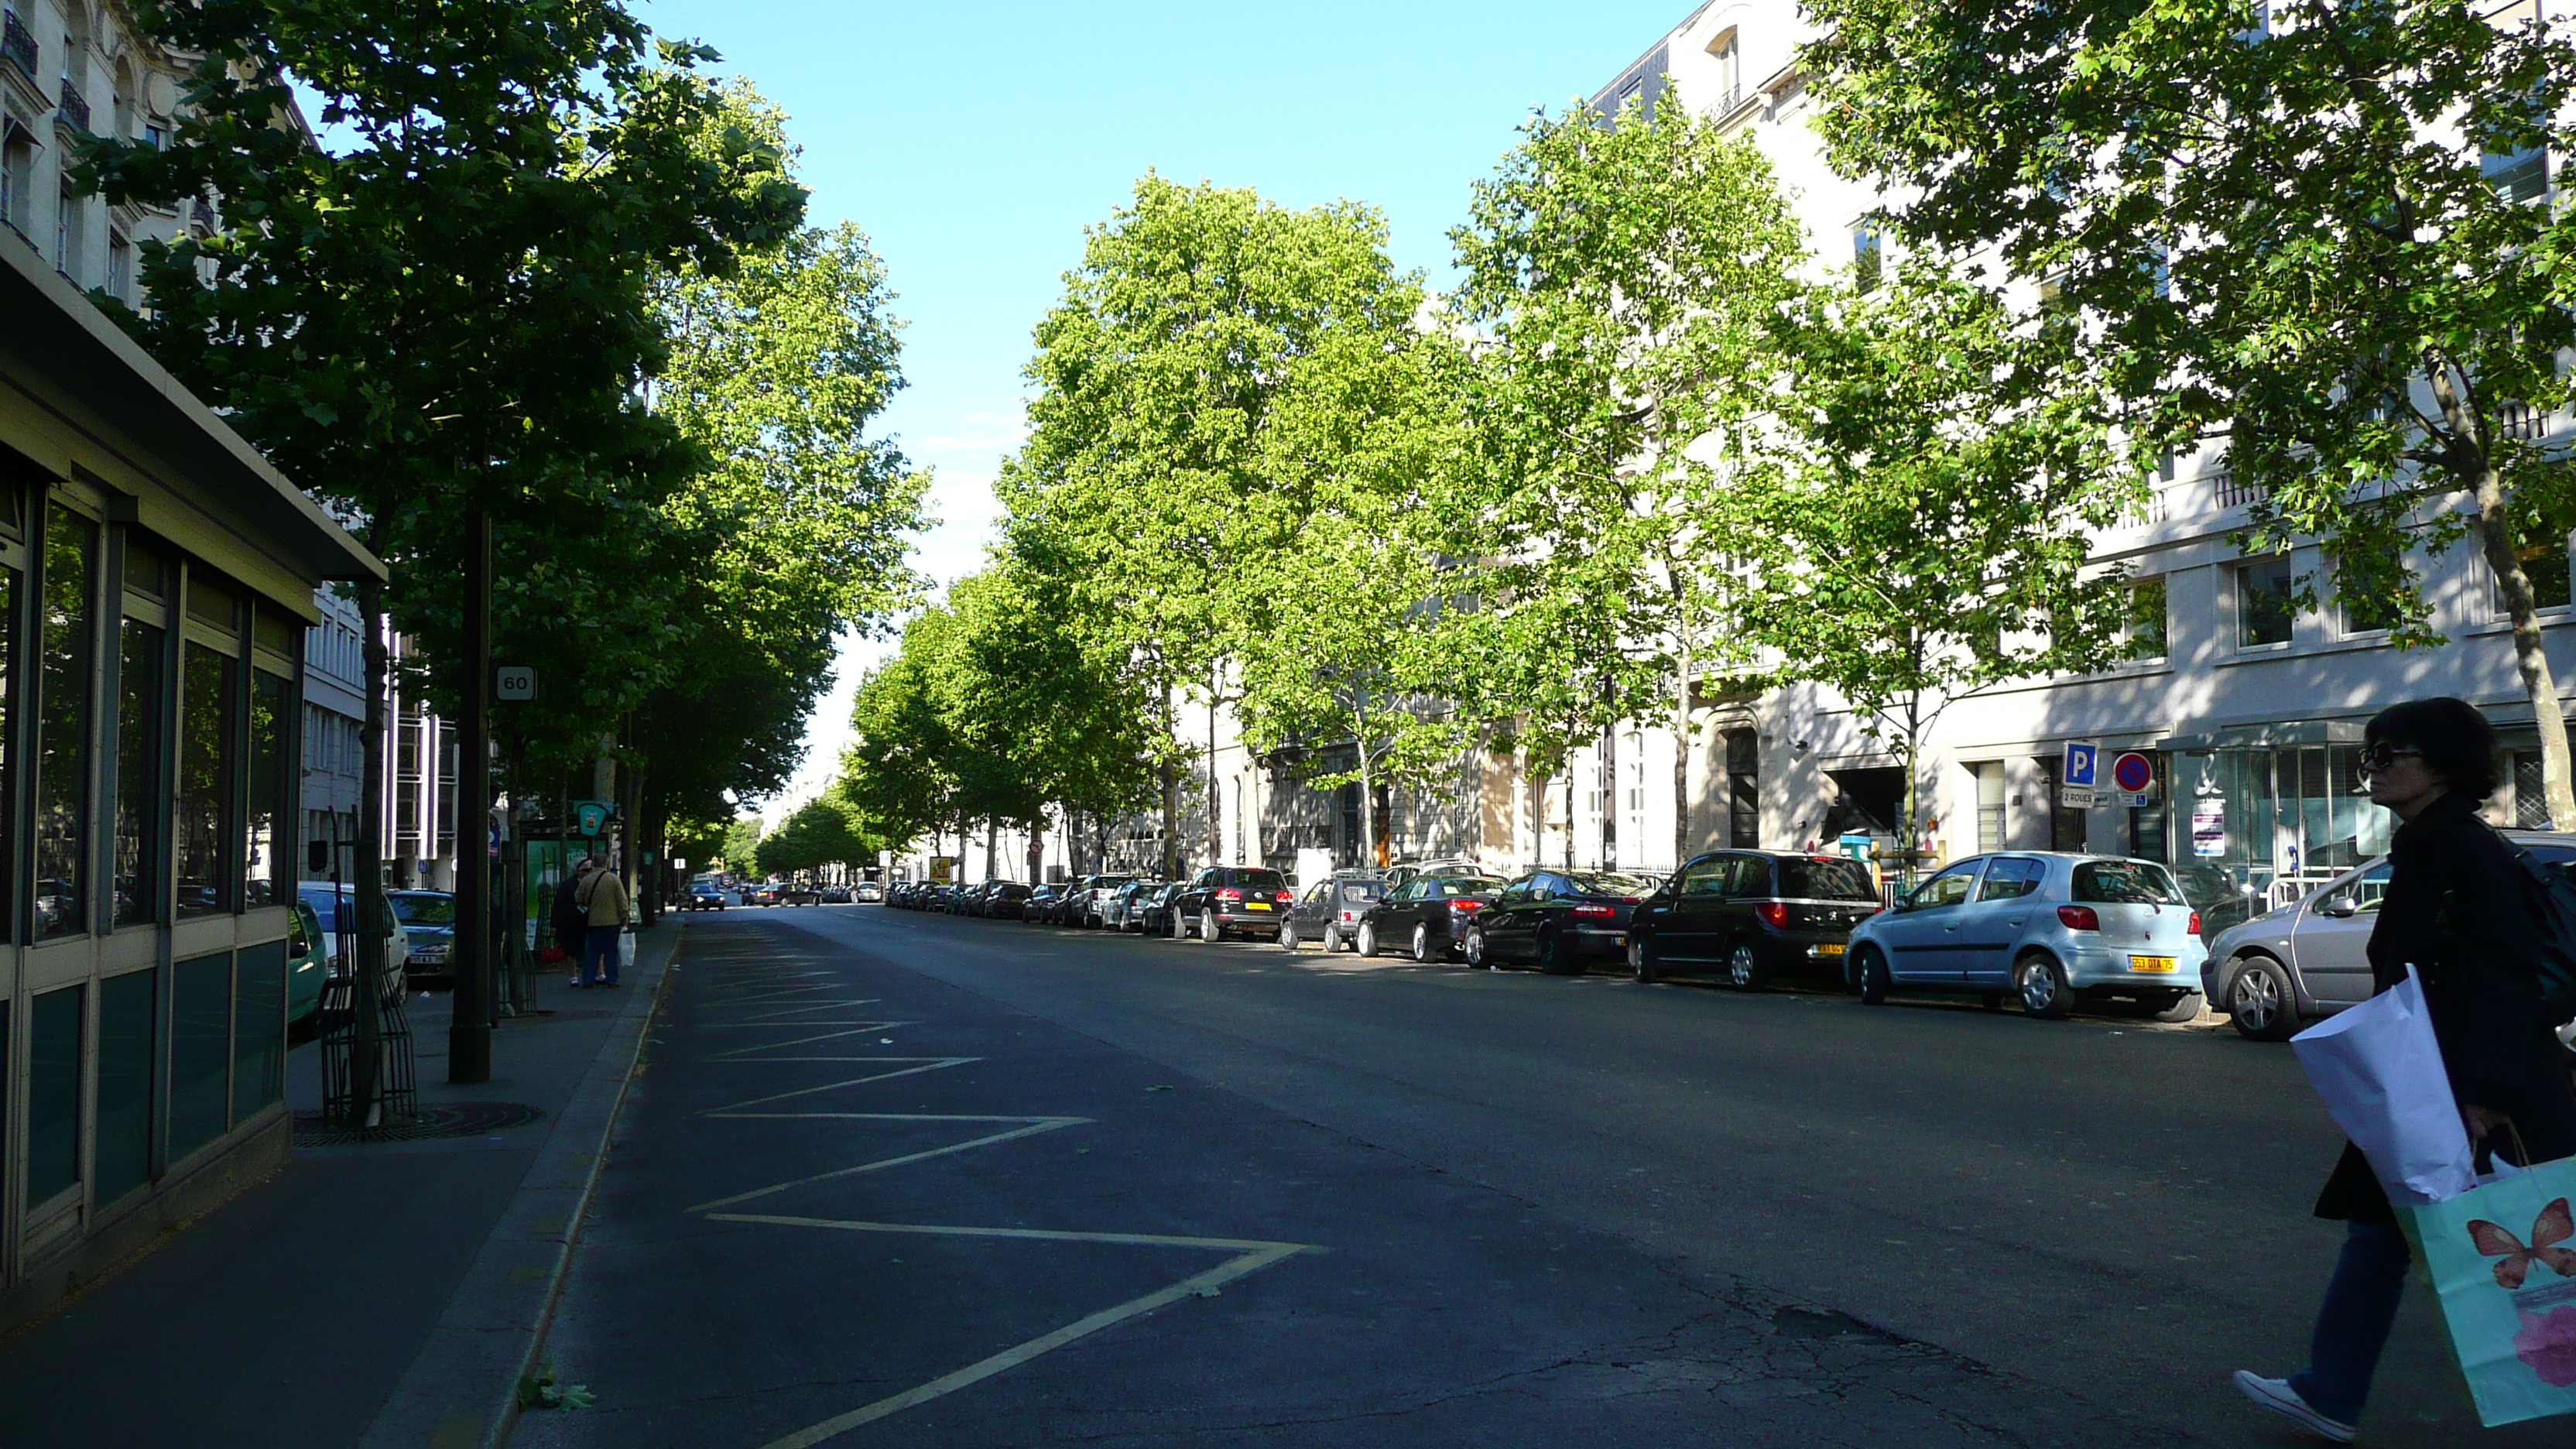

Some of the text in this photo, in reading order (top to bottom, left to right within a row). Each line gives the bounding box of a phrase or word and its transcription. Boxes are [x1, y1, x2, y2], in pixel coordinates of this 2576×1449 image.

[505, 677, 527, 690] 60
[2073, 751, 2088, 777] P
[2064, 793, 2069, 801] 2
[2070, 793, 2092, 803] ROUES
[567, 849, 588, 861] resh
[2163, 960, 2173, 970] 75
